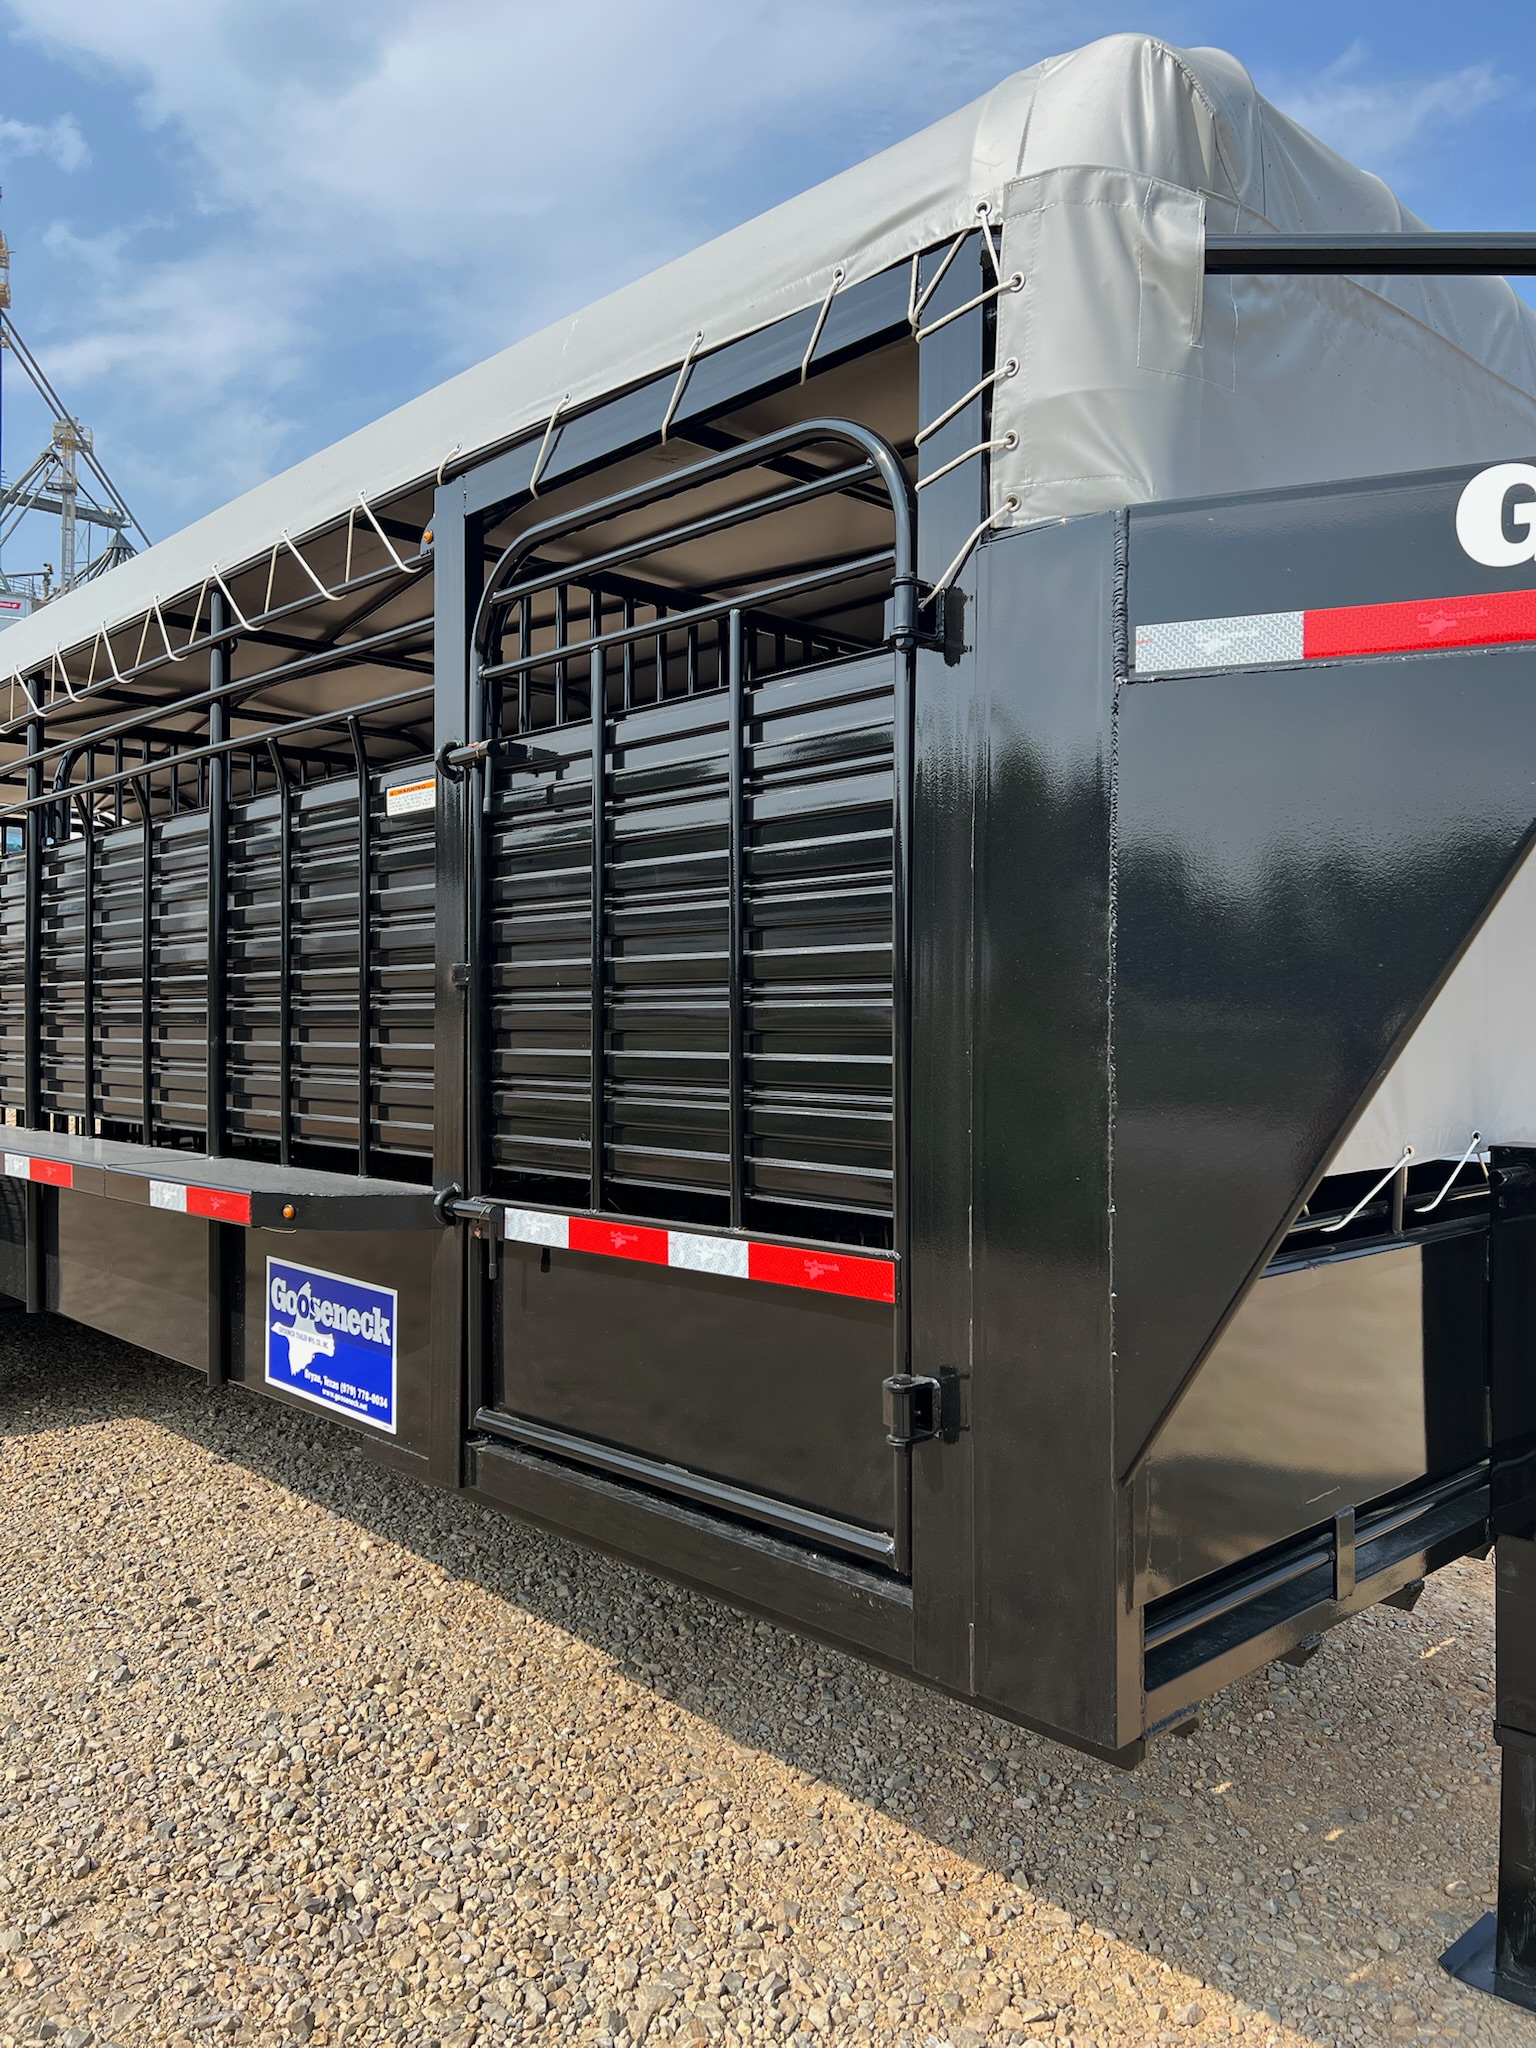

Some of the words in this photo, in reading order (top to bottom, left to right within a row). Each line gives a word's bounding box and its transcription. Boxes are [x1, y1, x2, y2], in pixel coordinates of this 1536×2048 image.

[398, 784, 426, 794] WARNING
[271, 1277, 391, 1346] Gooseneck
[304, 1368, 323, 1386] Bryan,
[323, 1375, 339, 1391] Texas
[340, 1382, 356, 1398] (979)
[357, 1388, 389, 1409] 778-0034
[322, 1388, 369, 1411] www.gooseneck.net
